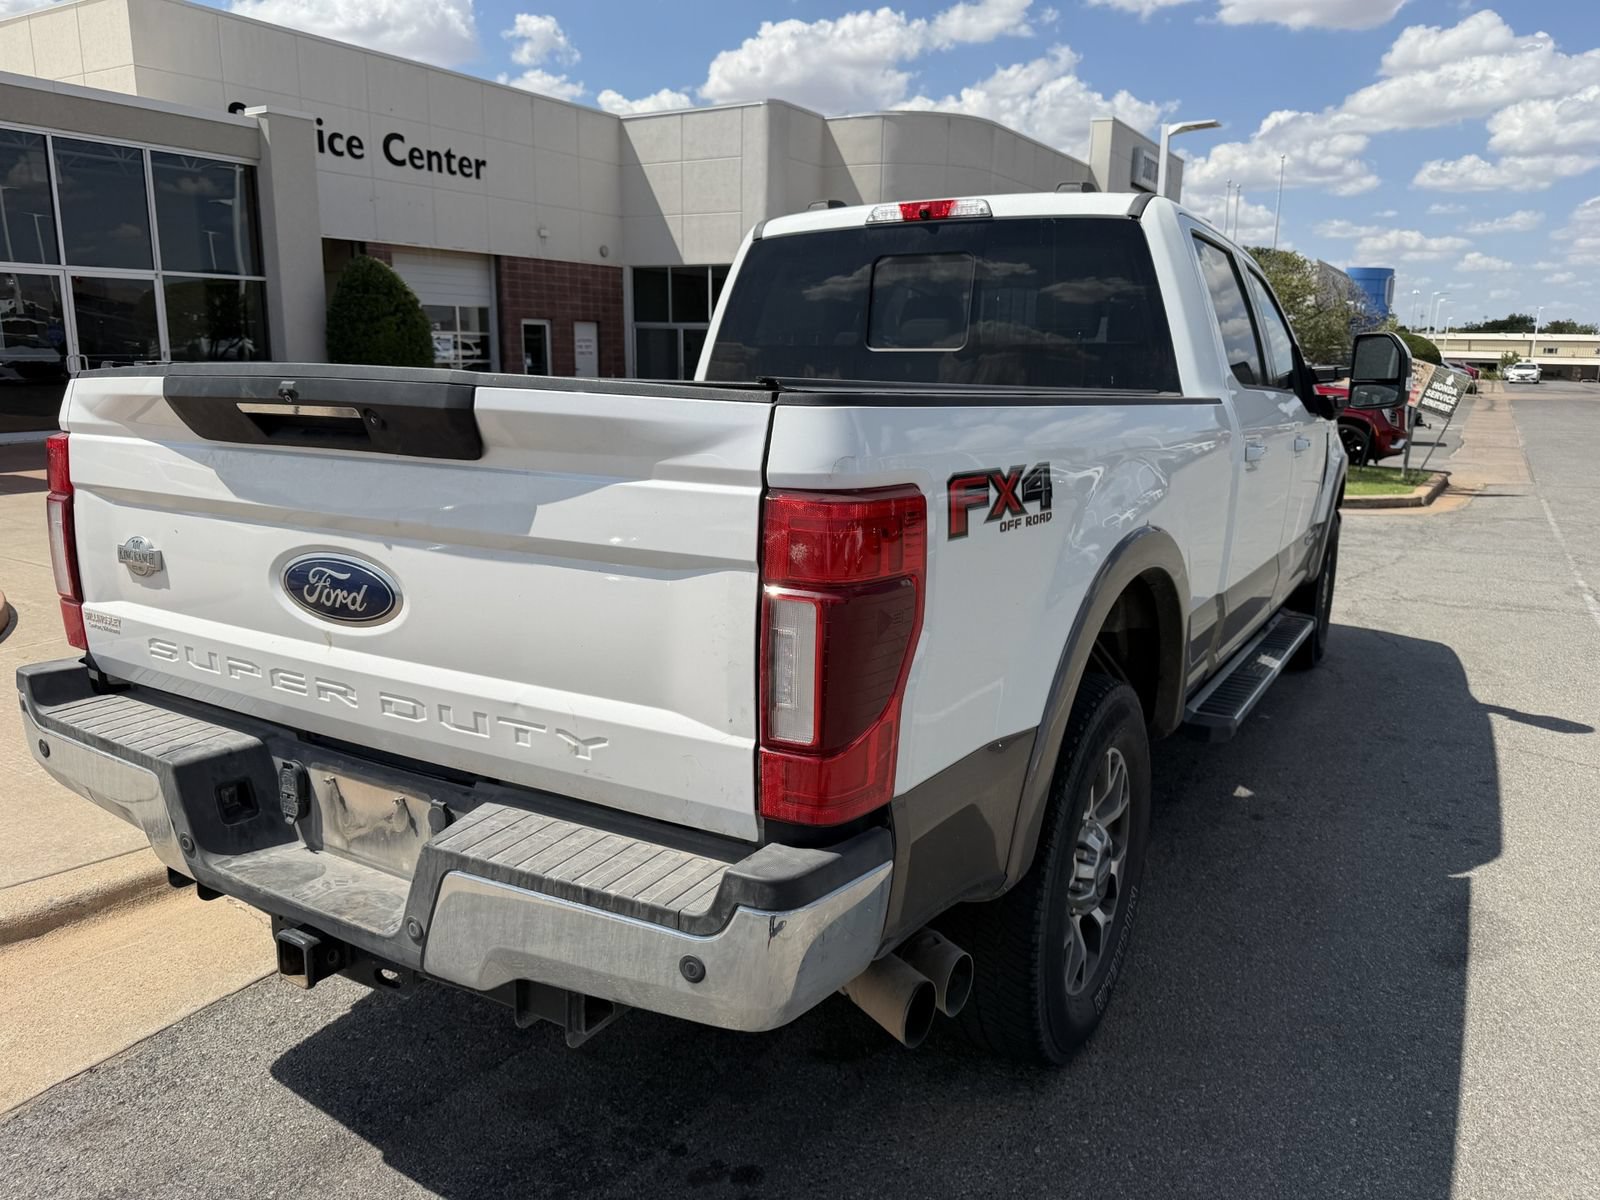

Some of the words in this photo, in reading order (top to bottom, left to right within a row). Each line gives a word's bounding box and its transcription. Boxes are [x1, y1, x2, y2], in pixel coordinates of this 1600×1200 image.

[382, 132, 487, 180] Center
[1425, 388, 1458, 405] SERVICE
[1431, 381, 1458, 396] HONDA
[946, 461, 1053, 541] FX4
[999, 519, 1022, 533] OFF
[1025, 511, 1053, 527] ROAD
[119, 547, 134, 562] KING
[303, 566, 369, 612] Ford
[147, 637, 359, 709] SUPER
[378, 691, 609, 761] DUTY
